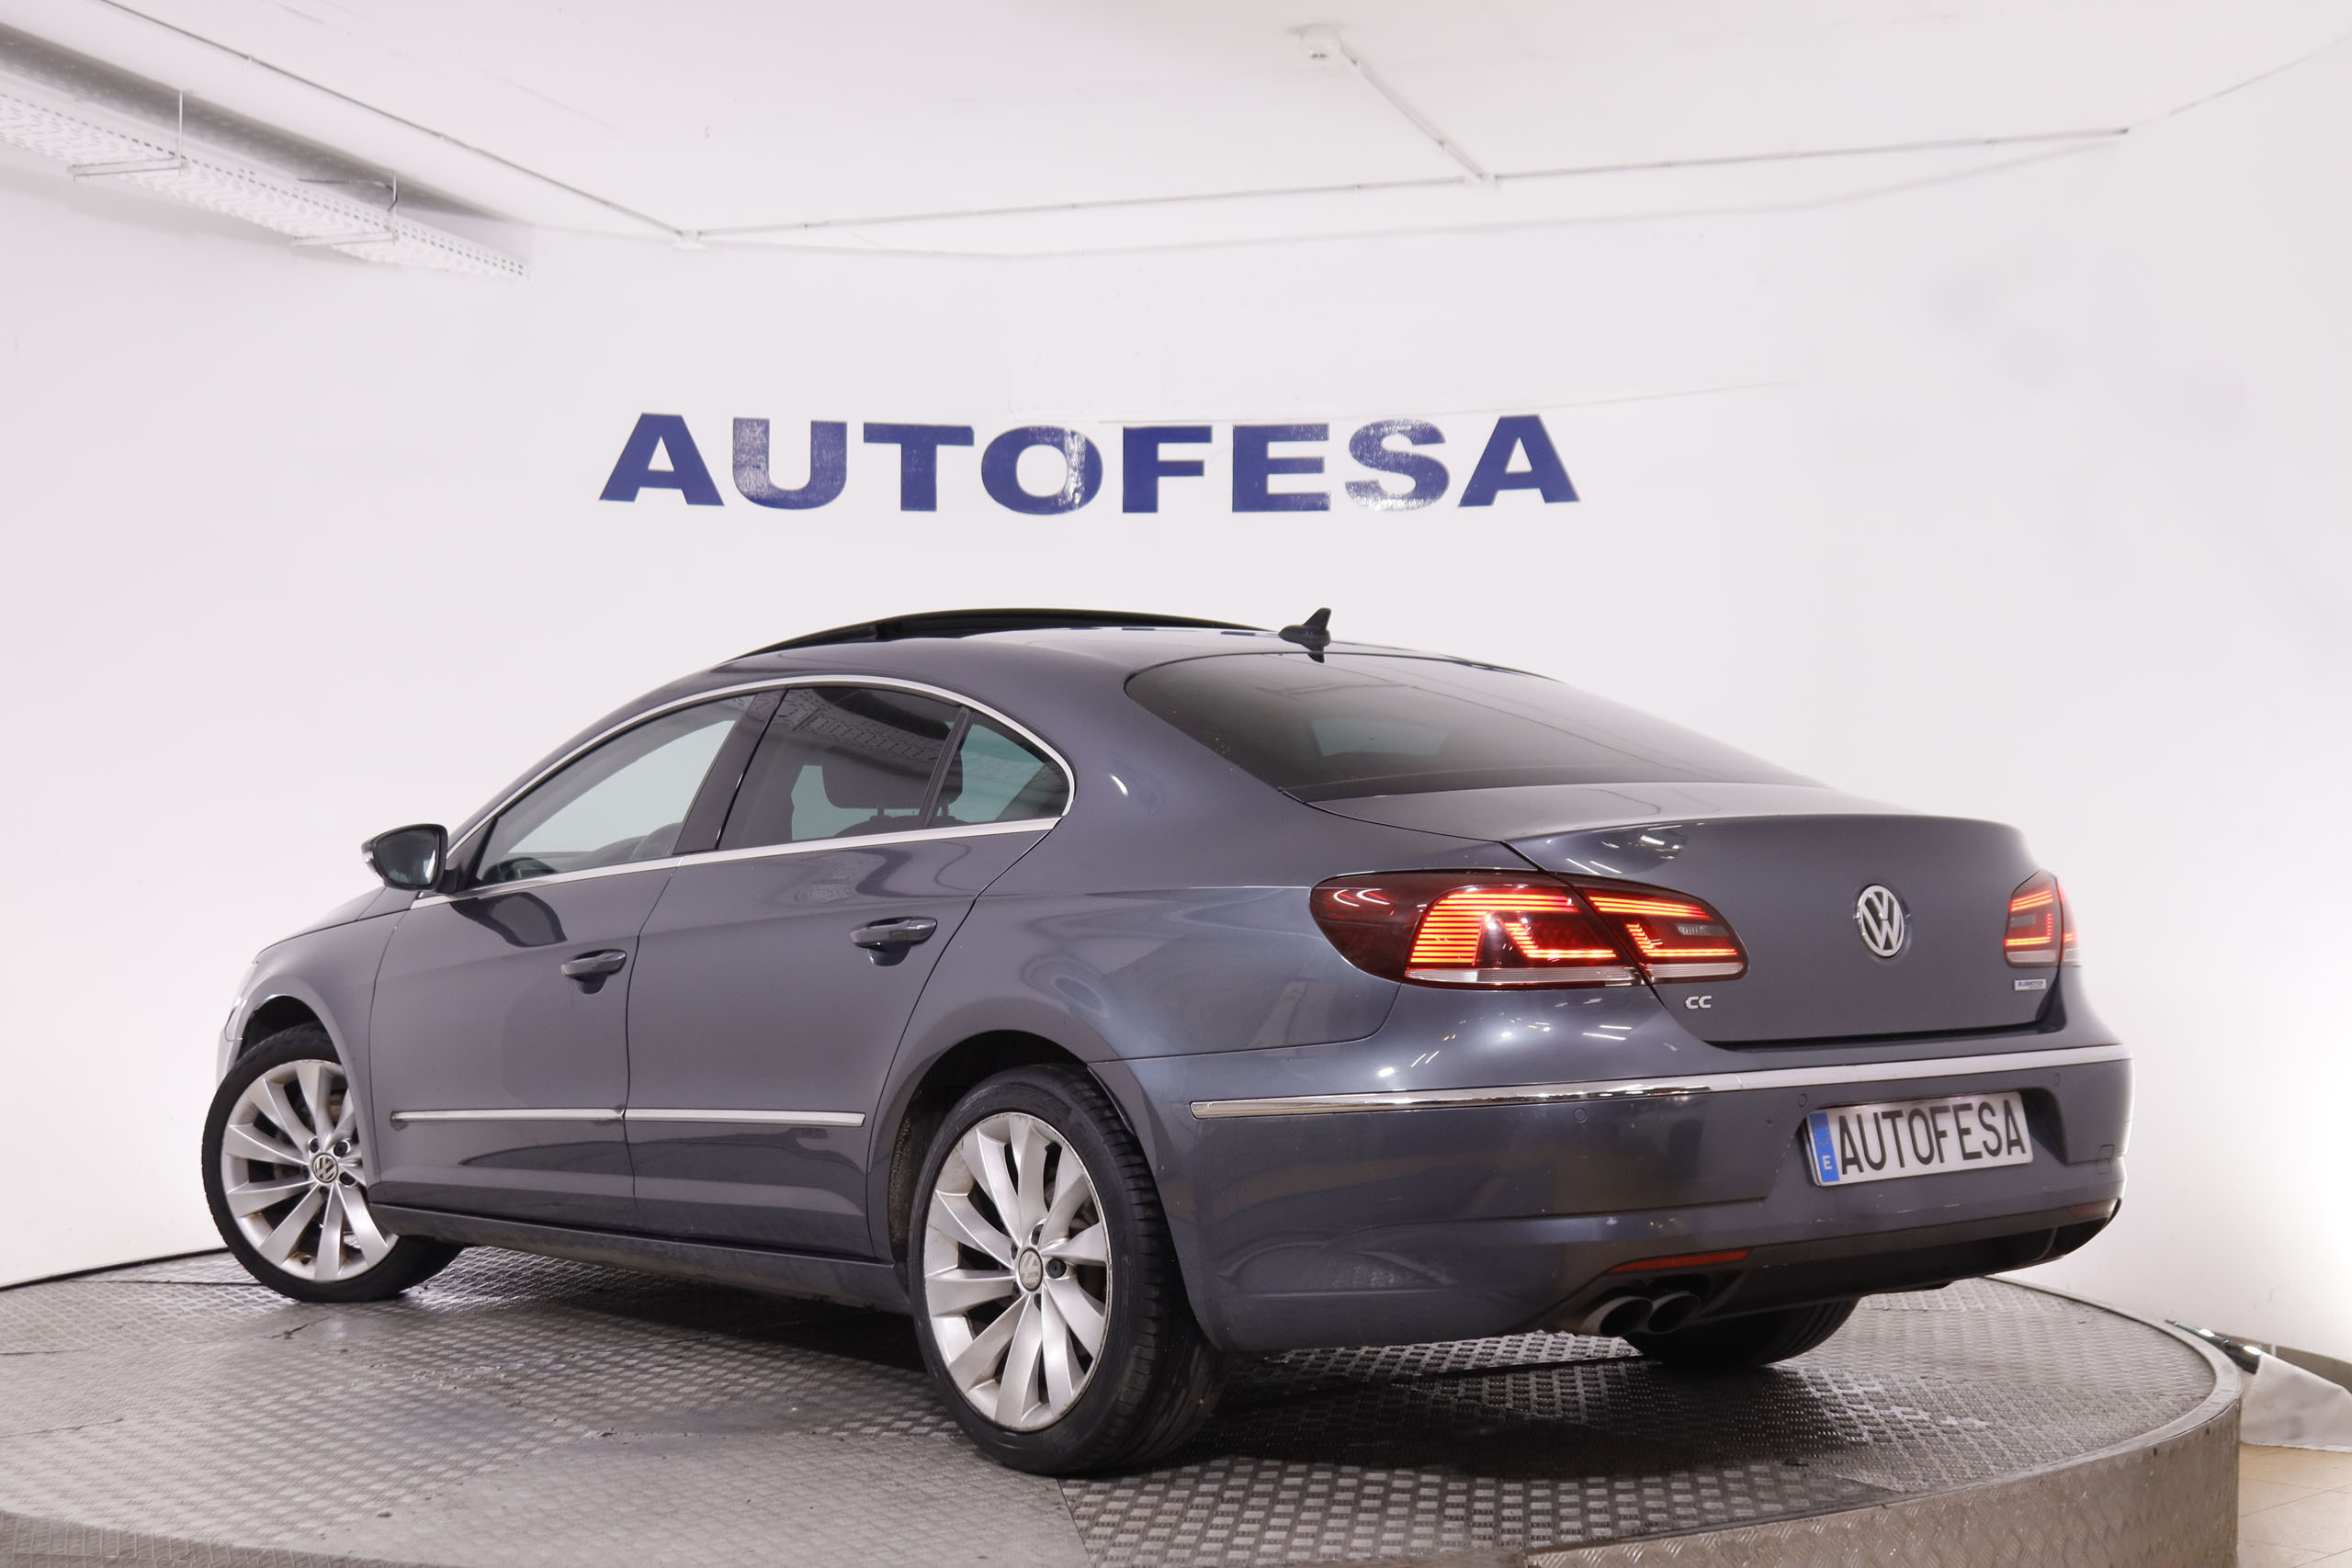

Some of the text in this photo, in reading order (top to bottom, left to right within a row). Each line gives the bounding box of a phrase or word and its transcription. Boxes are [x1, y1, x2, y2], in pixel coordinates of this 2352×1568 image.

[600, 413, 1578, 515] AUTOFESA
[1685, 995, 1713, 1010] CC
[1838, 1099, 2027, 1176] AUTOFESA
[1822, 1155, 1833, 1170] E
